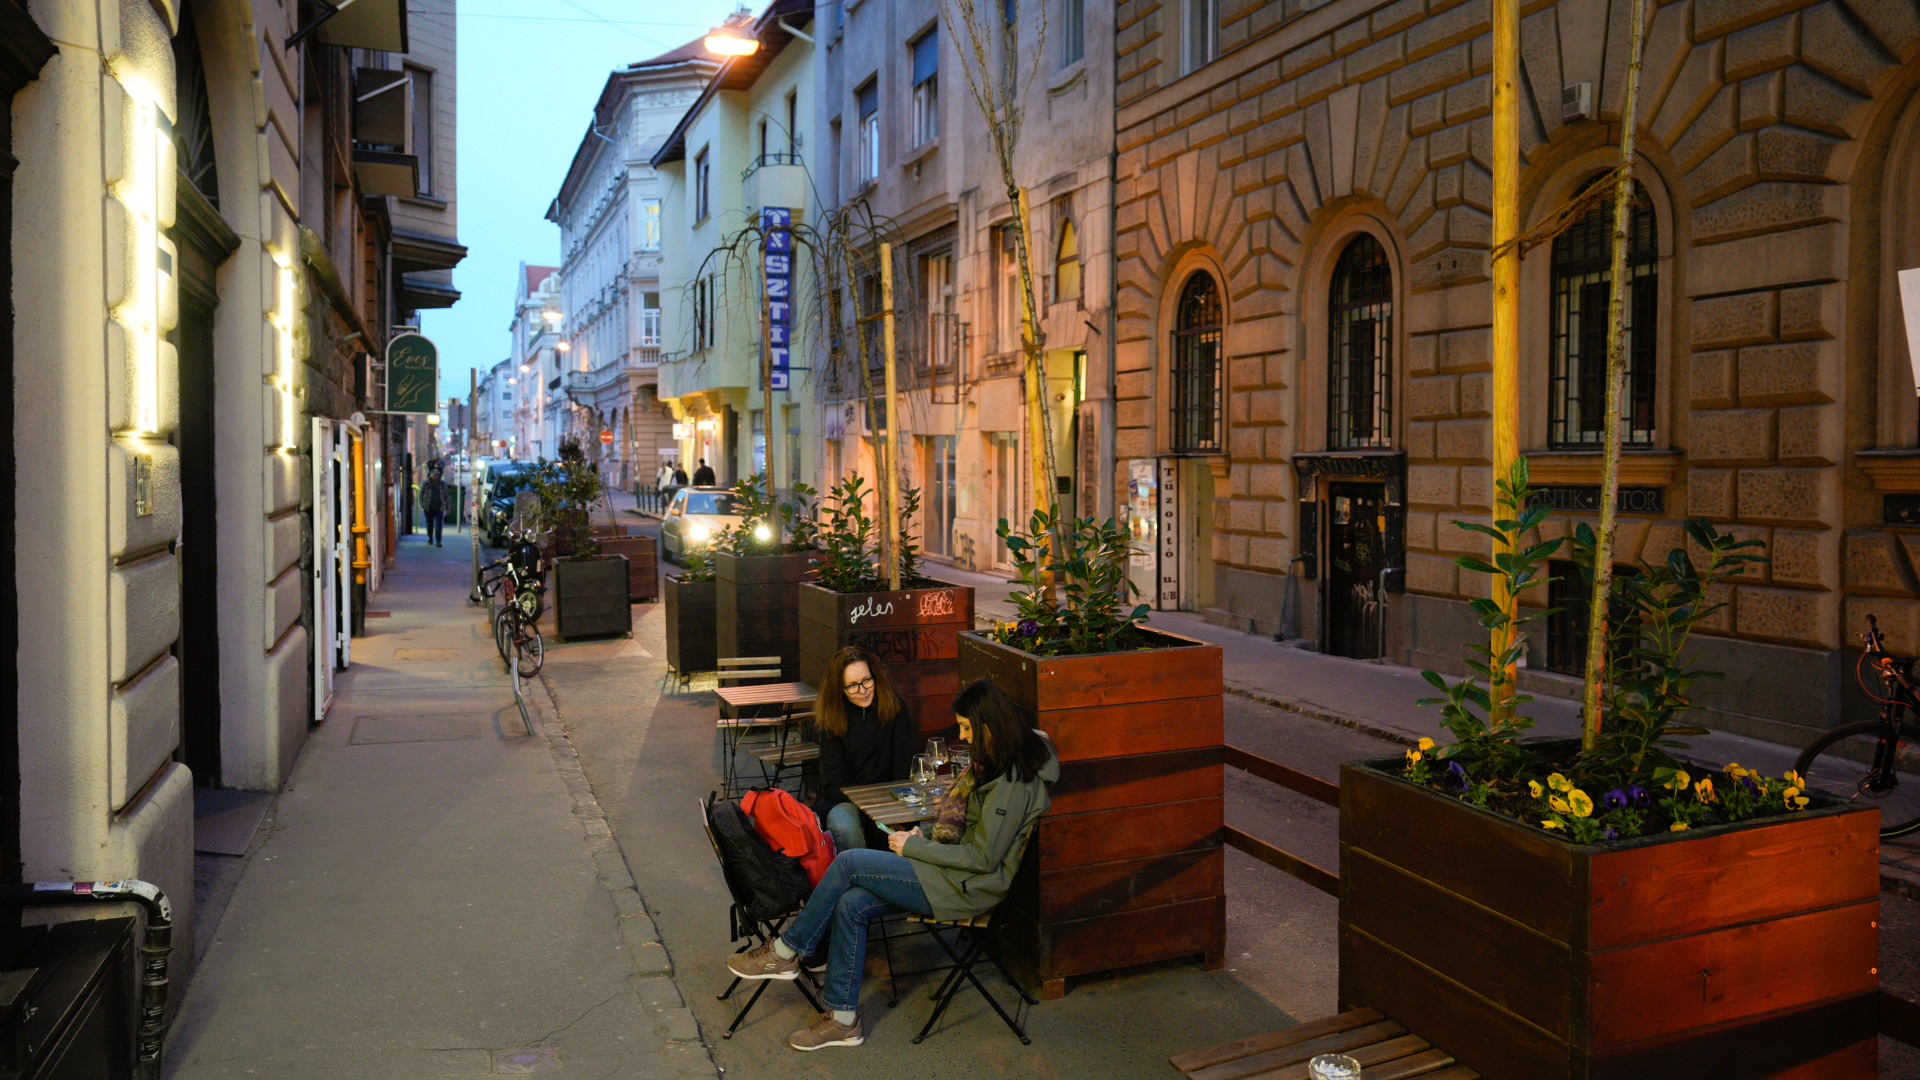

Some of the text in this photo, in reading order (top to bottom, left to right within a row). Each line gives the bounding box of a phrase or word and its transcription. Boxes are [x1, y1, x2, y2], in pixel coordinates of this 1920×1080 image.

[1529, 489, 1659, 511] ANTIK TOR
[1163, 576, 1177, 584] u.
[1162, 591, 1177, 600] 1/B
